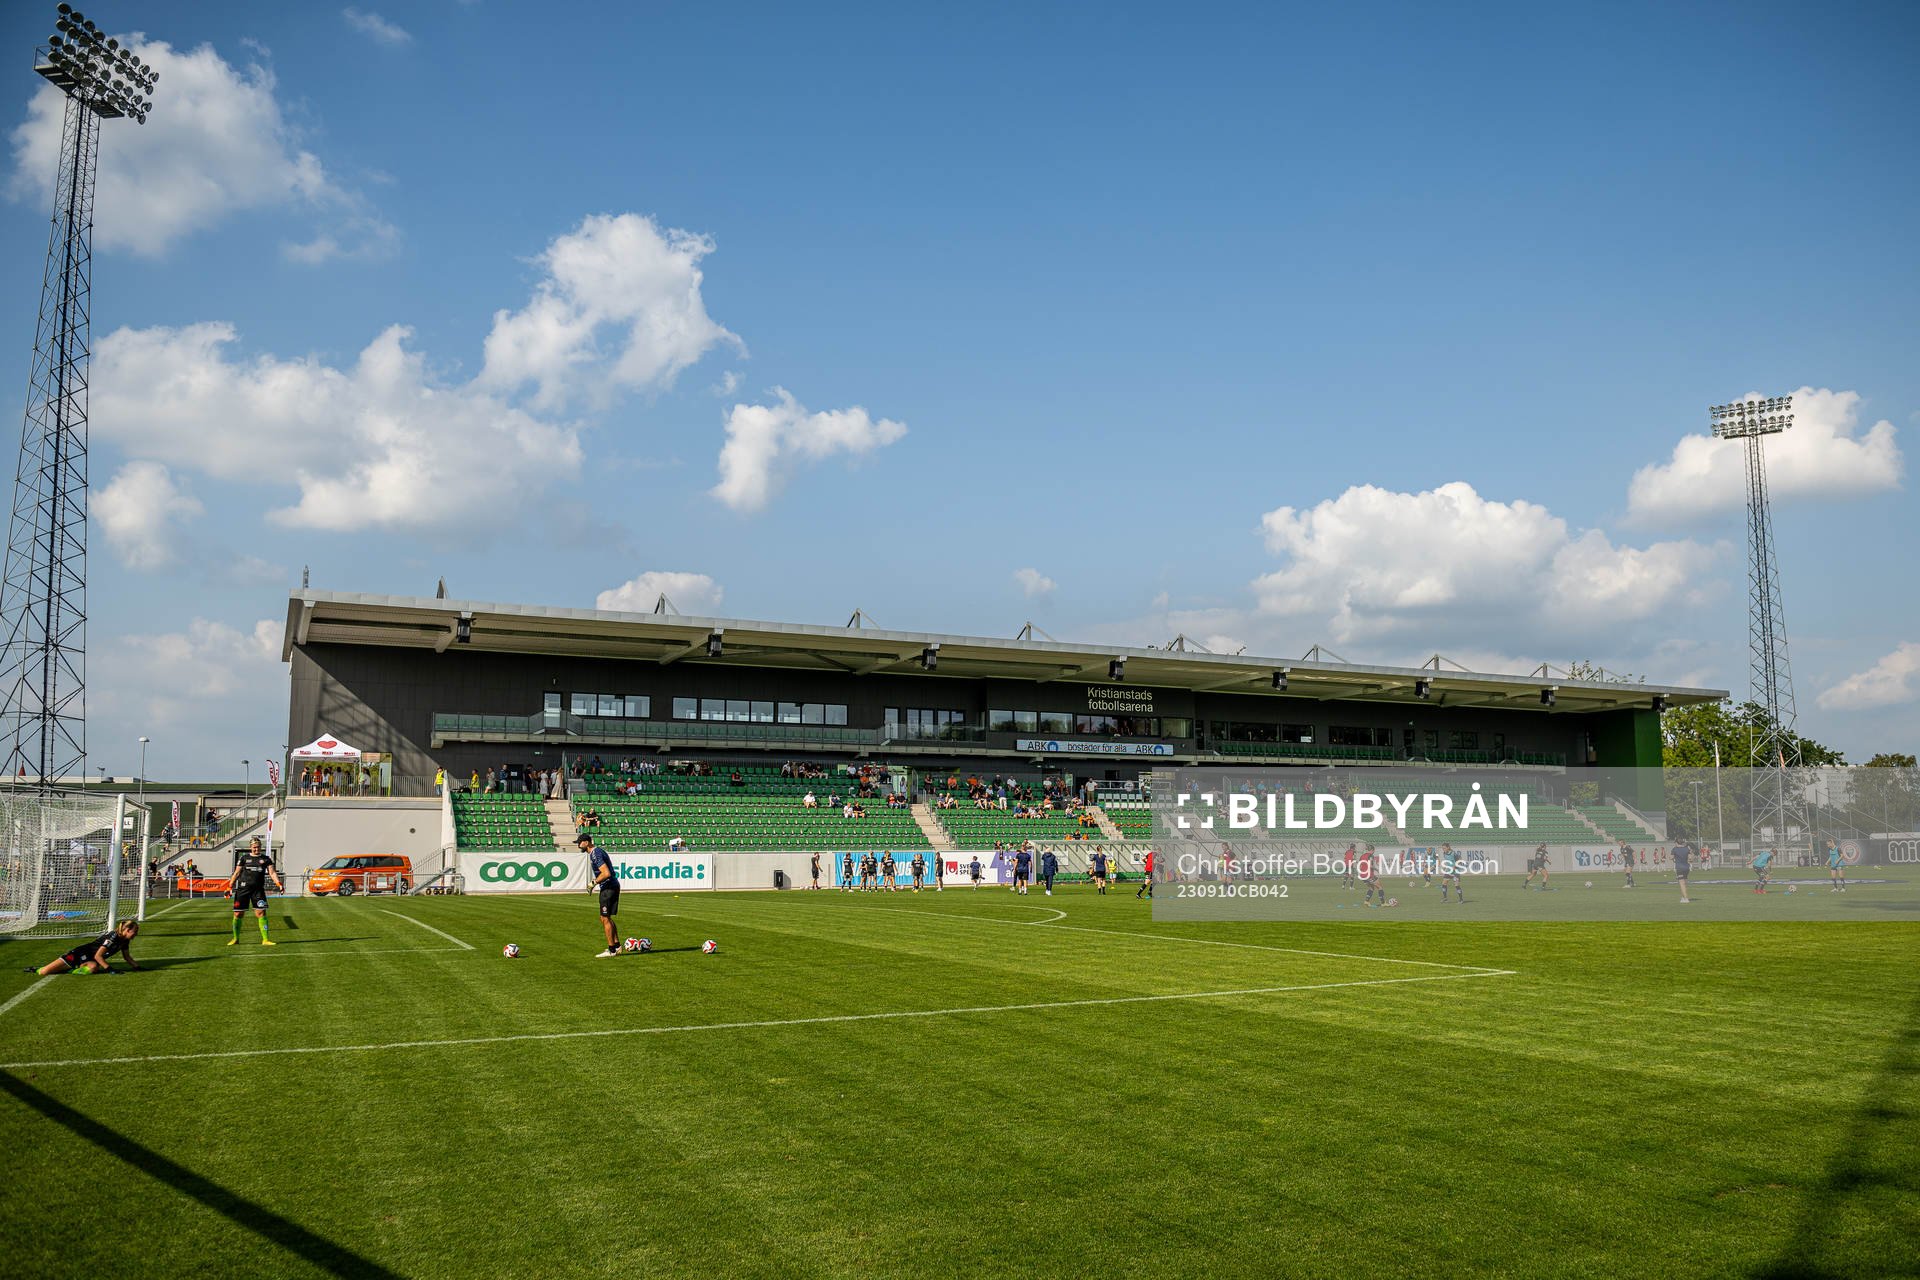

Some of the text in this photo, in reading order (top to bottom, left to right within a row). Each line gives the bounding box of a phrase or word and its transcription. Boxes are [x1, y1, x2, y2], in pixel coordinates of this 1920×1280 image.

[1087, 687, 1153, 701] Kristianstads
[1087, 699, 1154, 713] fotbollsarena
[1027, 741, 1048, 751] ABK
[1114, 745, 1127, 753] alla
[1135, 744, 1154, 755] ABK
[479, 861, 570, 888] coop
